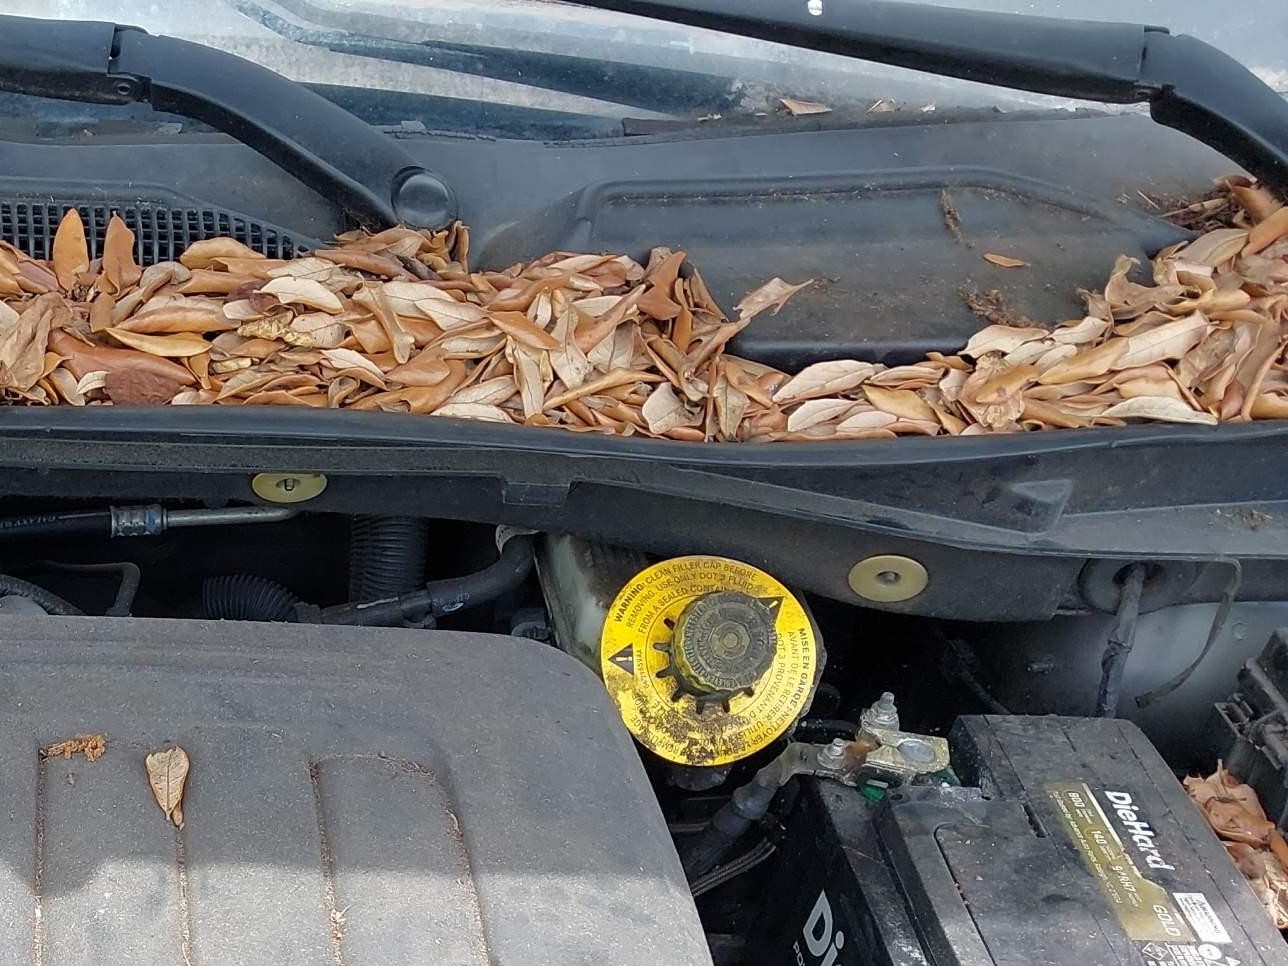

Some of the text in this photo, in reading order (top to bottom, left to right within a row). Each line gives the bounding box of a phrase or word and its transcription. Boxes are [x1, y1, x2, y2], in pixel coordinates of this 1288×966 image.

[615, 582, 646, 622] WARNING:
[645, 567, 672, 584] CLEAN
[672, 562, 701, 573] FILLER
[656, 578, 673, 591] USE
[673, 573, 696, 584] ONLY
[699, 572, 718, 580] DOT
[638, 611, 654, 634] FROM
[657, 587, 689, 606] SEALED
[787, 631, 800, 660] AVANT
[799, 628, 810, 653] MISE
[802, 655, 810, 670] EN
[1103, 790, 1175, 871] DieHard
[1153, 904, 1181, 938] GOLD
